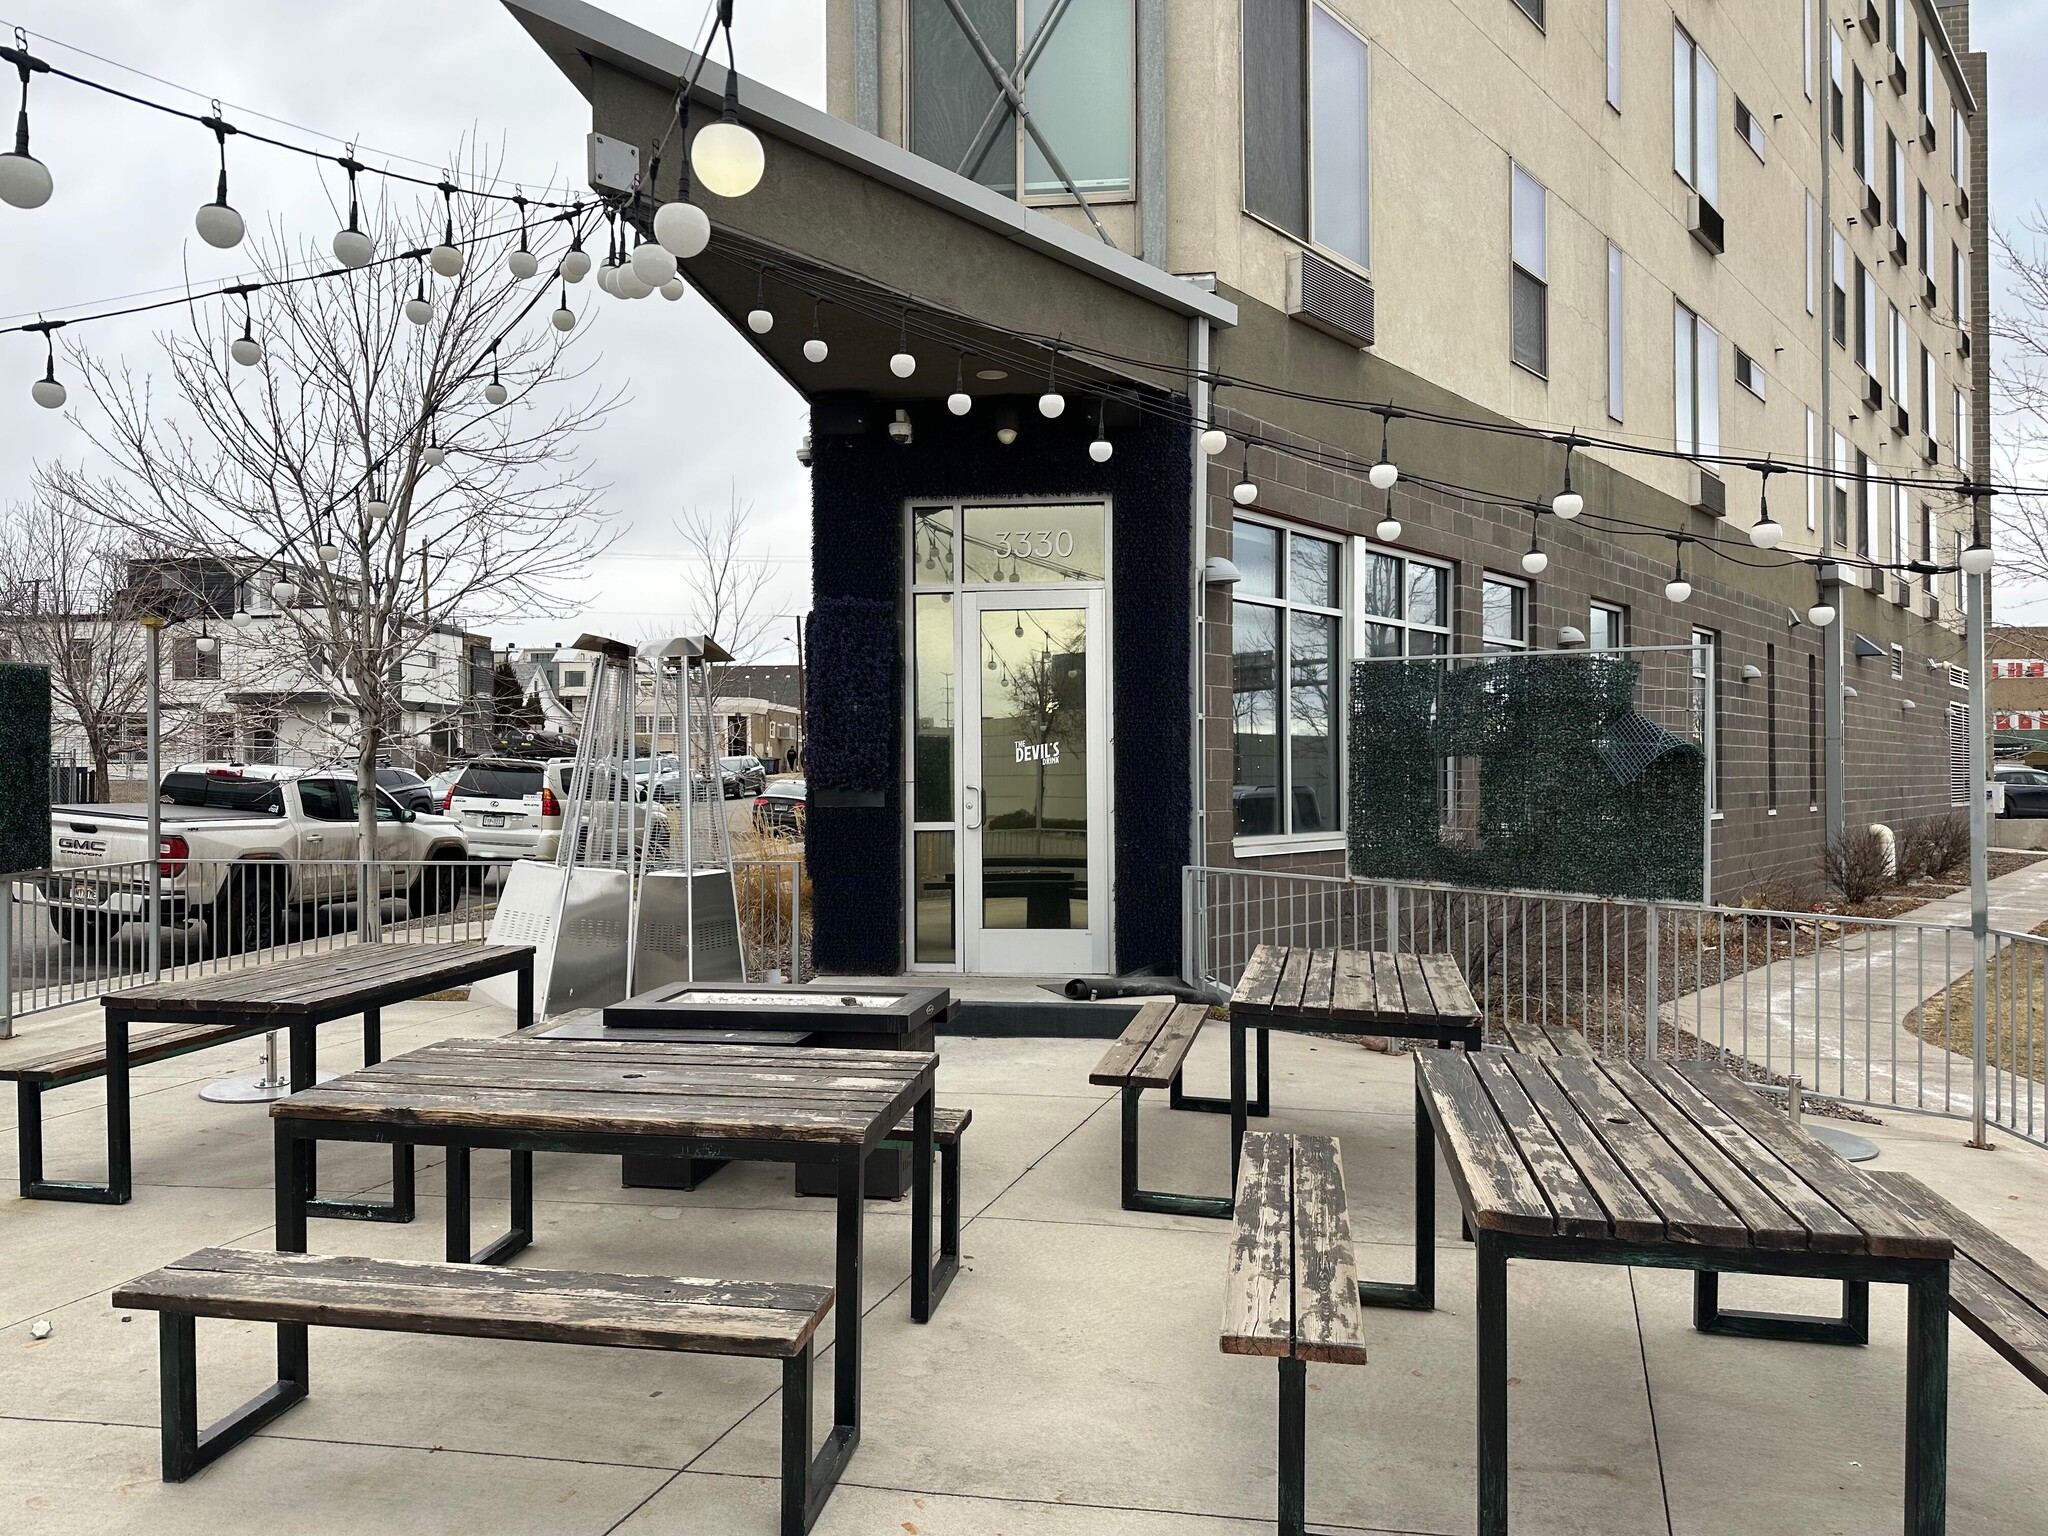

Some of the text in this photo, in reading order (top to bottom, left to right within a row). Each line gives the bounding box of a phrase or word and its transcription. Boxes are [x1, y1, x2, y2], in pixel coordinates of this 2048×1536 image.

[994, 530, 1074, 559] 3330
[1014, 740, 1026, 748] THE
[1015, 742, 1060, 763] DEVIL'S
[1042, 756, 1060, 766] DRINK
[58, 838, 106, 851] GMC
